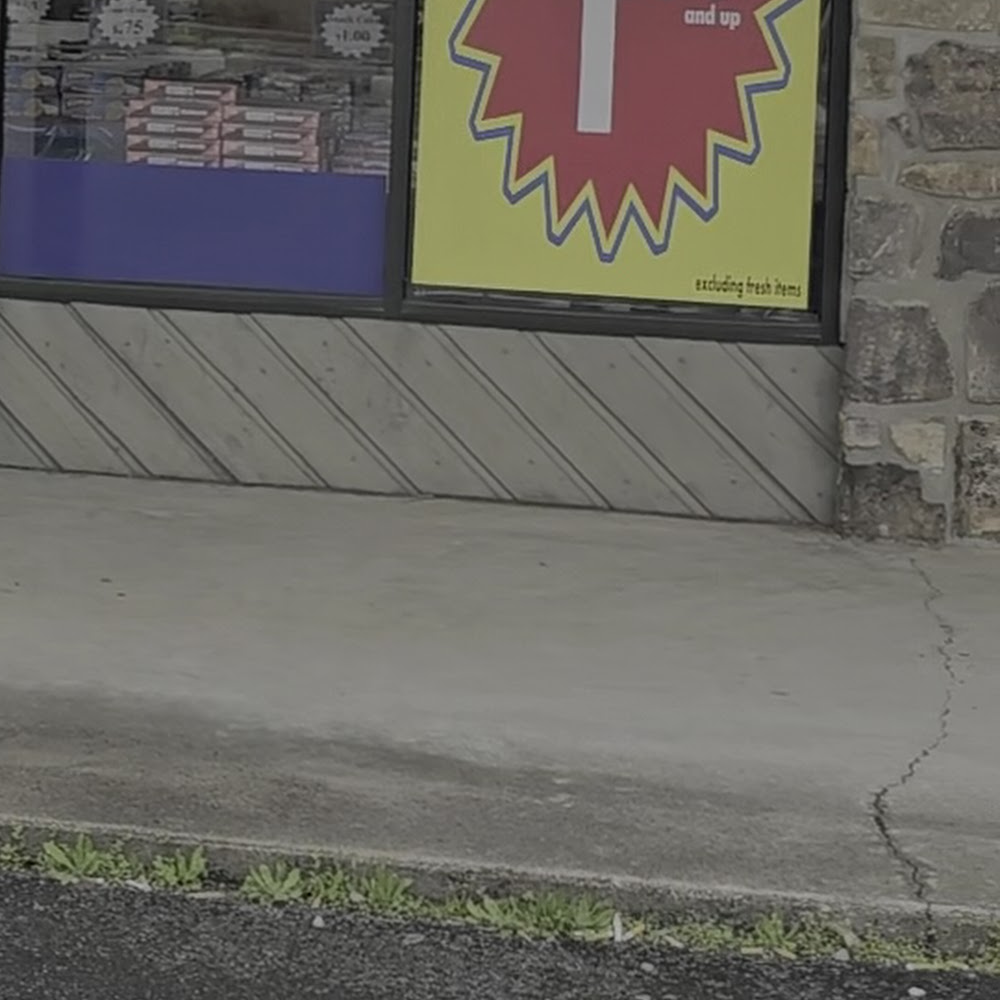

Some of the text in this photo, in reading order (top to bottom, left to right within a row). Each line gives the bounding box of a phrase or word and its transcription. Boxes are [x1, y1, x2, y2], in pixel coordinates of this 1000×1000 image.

[683, 3, 742, 31] and up
[695, 273, 802, 299] excluding fresh items
